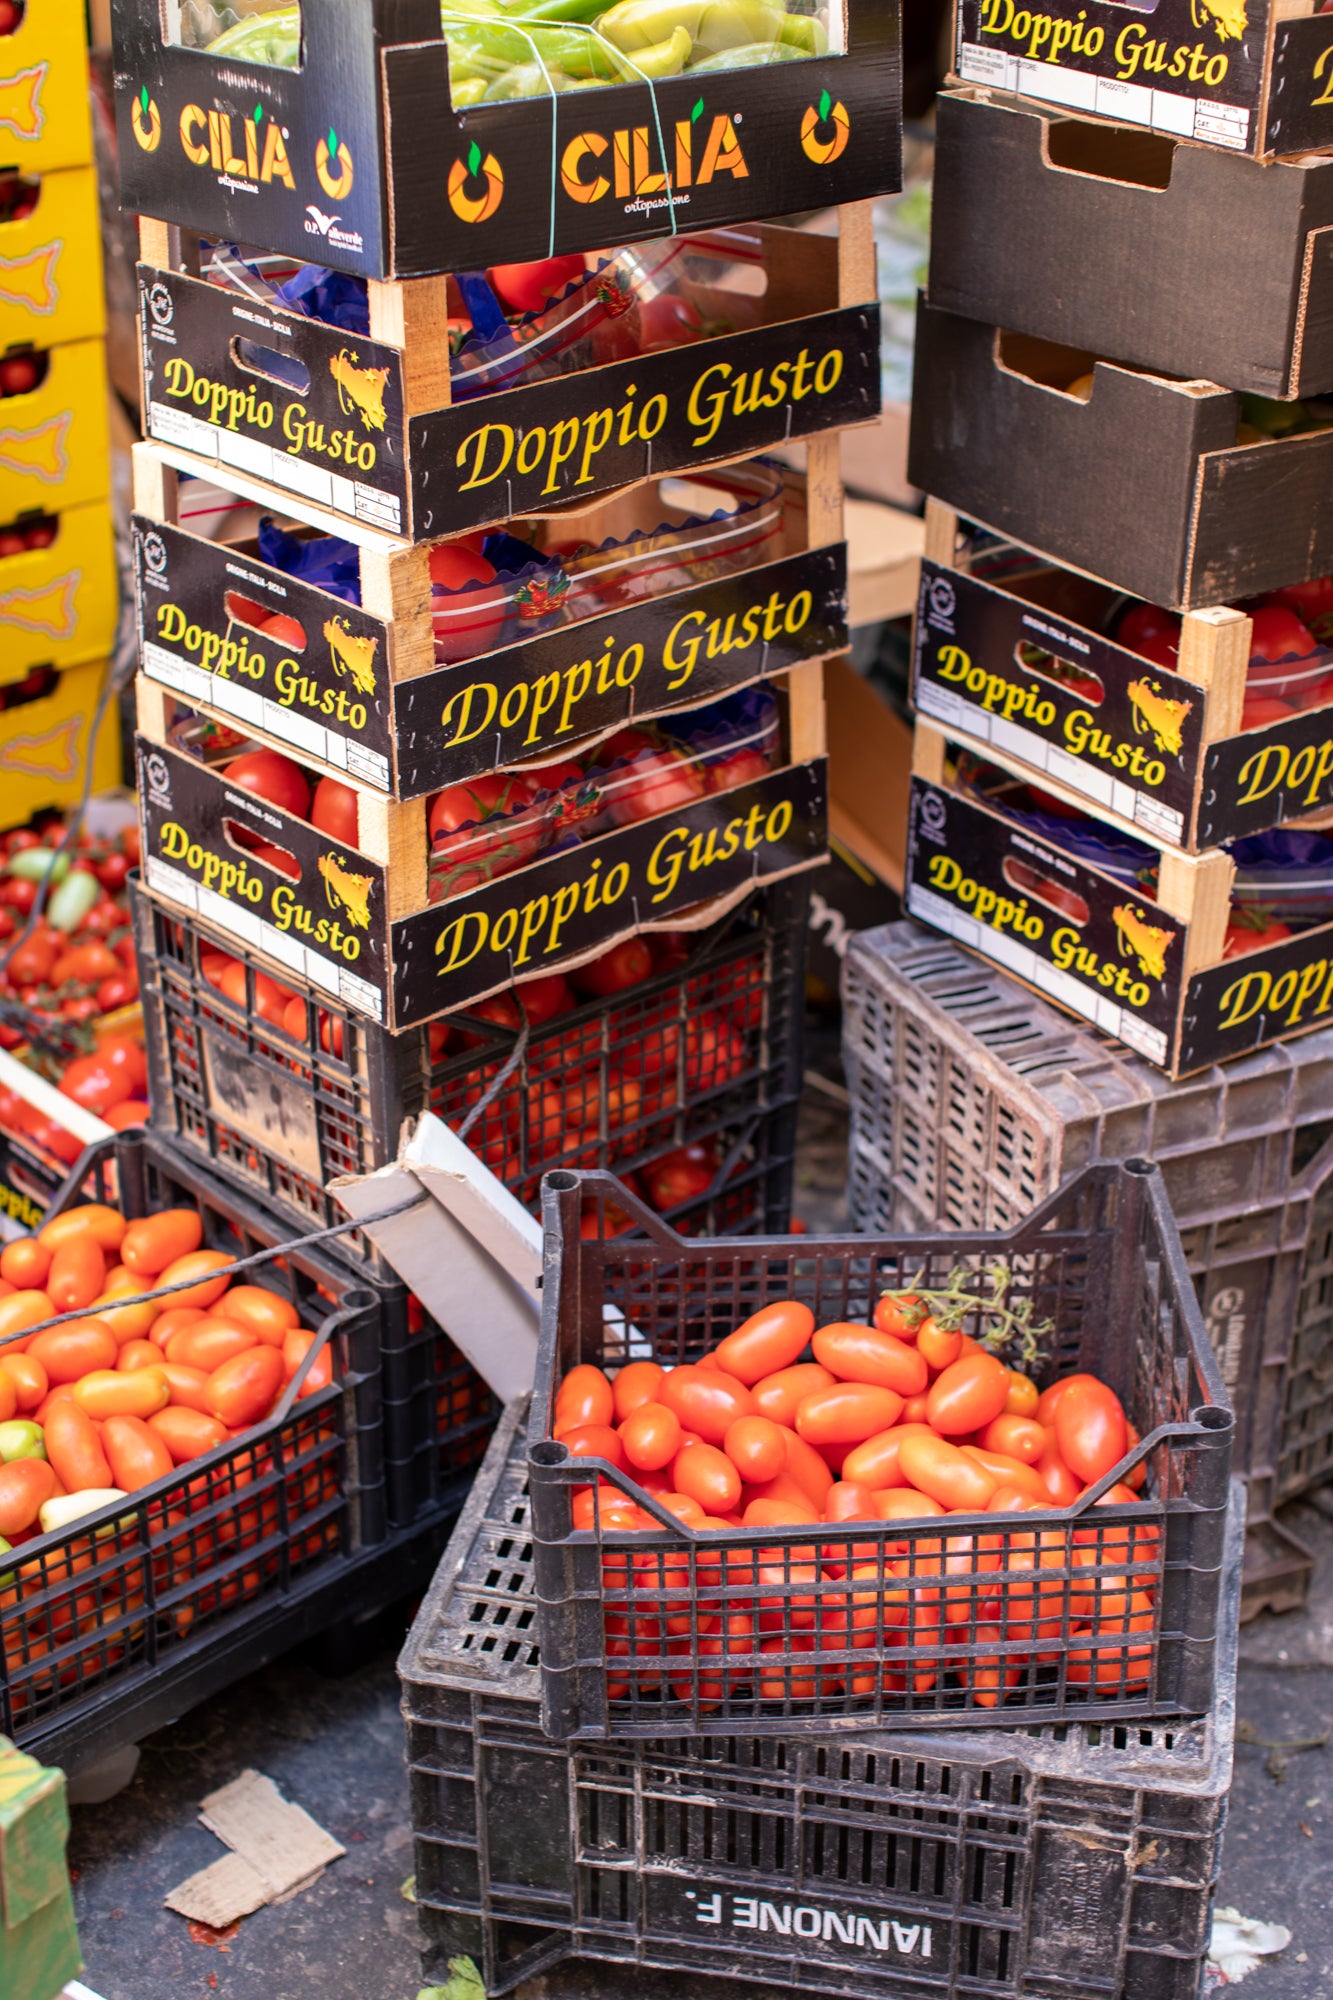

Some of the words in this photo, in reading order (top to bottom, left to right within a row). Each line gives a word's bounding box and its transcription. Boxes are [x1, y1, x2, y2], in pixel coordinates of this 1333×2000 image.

[980, 0, 1105, 64] Doppio
[1115, 23, 1229, 87] Gusto
[624, 194, 691, 218] ortopassone
[163, 358, 275, 432] Doppio
[282, 403, 377, 471] Gusto
[456, 384, 668, 496] Doppio
[687, 348, 844, 448] Gusto
[156, 603, 267, 680] Doppio
[273, 658, 368, 731] Gusto
[440, 635, 645, 748] Doppio
[661, 590, 813, 692] Gusto
[937, 645, 1057, 726] Doppio
[1063, 709, 1167, 787] Gusto
[159, 821, 264, 903] Doppio
[271, 885, 361, 961] Gusto
[434, 857, 630, 977] Doppio
[646, 799, 793, 905] Gusto
[928, 855, 1045, 941] Doppio
[1050, 927, 1152, 1007] Gusto
[685, 1890, 722, 1925] F.
[732, 1897, 932, 1958] IANNONE
